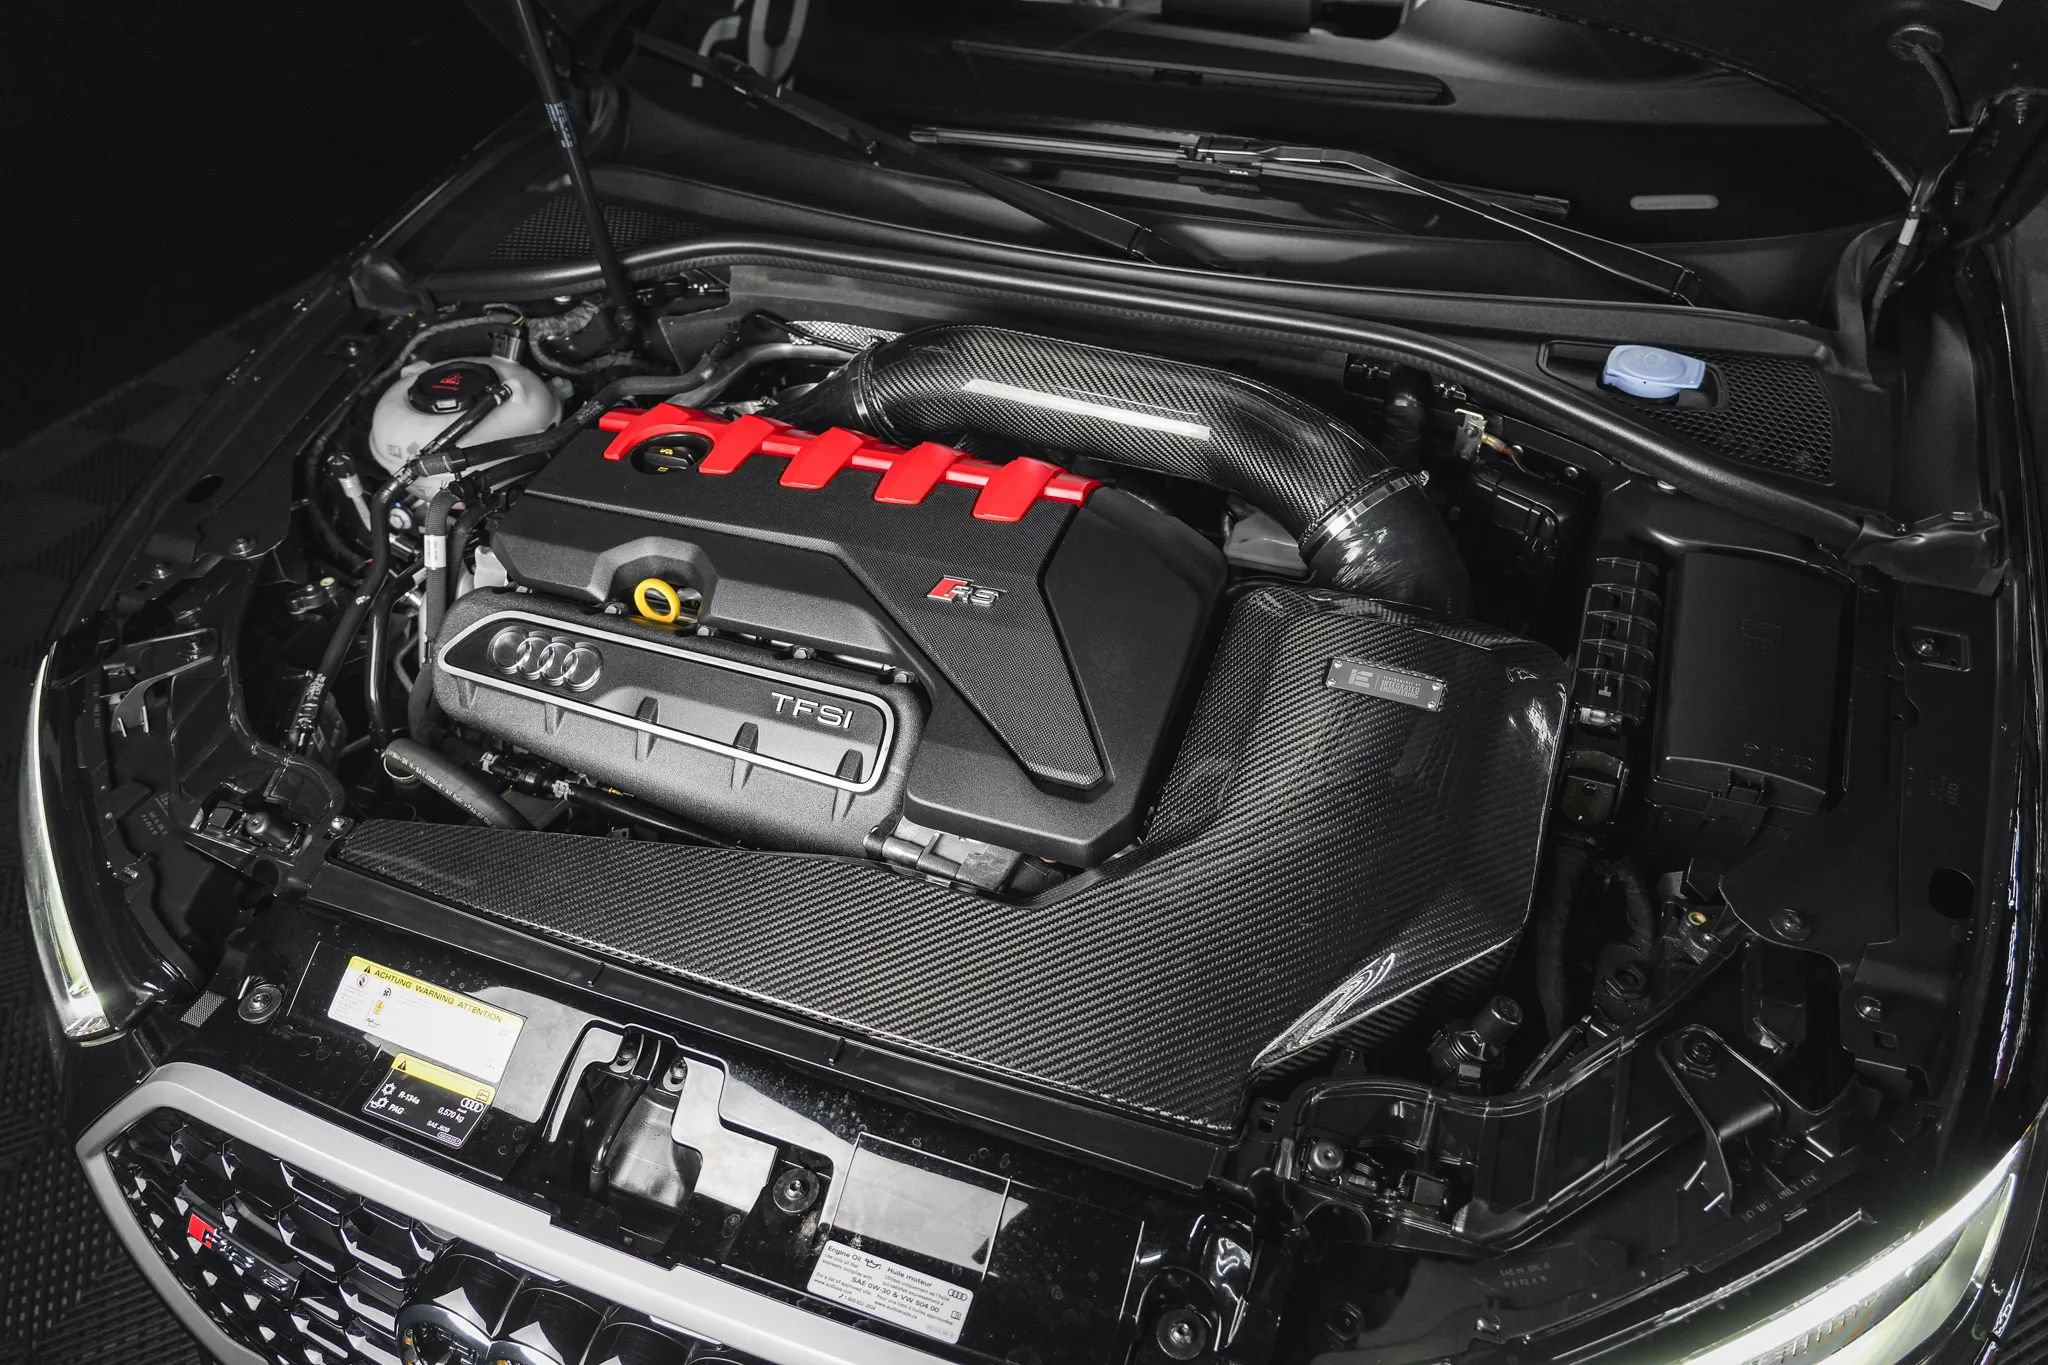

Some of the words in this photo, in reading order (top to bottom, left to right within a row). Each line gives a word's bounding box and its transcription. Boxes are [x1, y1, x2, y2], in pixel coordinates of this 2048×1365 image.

[927, 577, 1000, 606] RS
[1380, 679, 1420, 693] INTEGRATED
[772, 692, 854, 729] TFSI
[374, 969, 412, 989] ACHTUNG
[415, 983, 455, 1005] WARNING
[457, 1001, 503, 1023] ATTENTION
[398, 1091, 421, 1105] R-134a
[388, 1104, 405, 1115] PAG
[437, 1107, 456, 1118] 0,570
[455, 1113, 465, 1123] kg
[828, 1246, 851, 1257] Engine
[852, 1254, 862, 1262] Oil
[888, 1267, 905, 1278] Huile
[905, 1274, 932, 1287] moteur
[852, 1276, 867, 1287] SAE
[867, 1282, 891, 1295] 0W-30
[901, 1293, 914, 1303] VW
[915, 1299, 928, 1309] 504
[930, 1305, 940, 1313] 00
